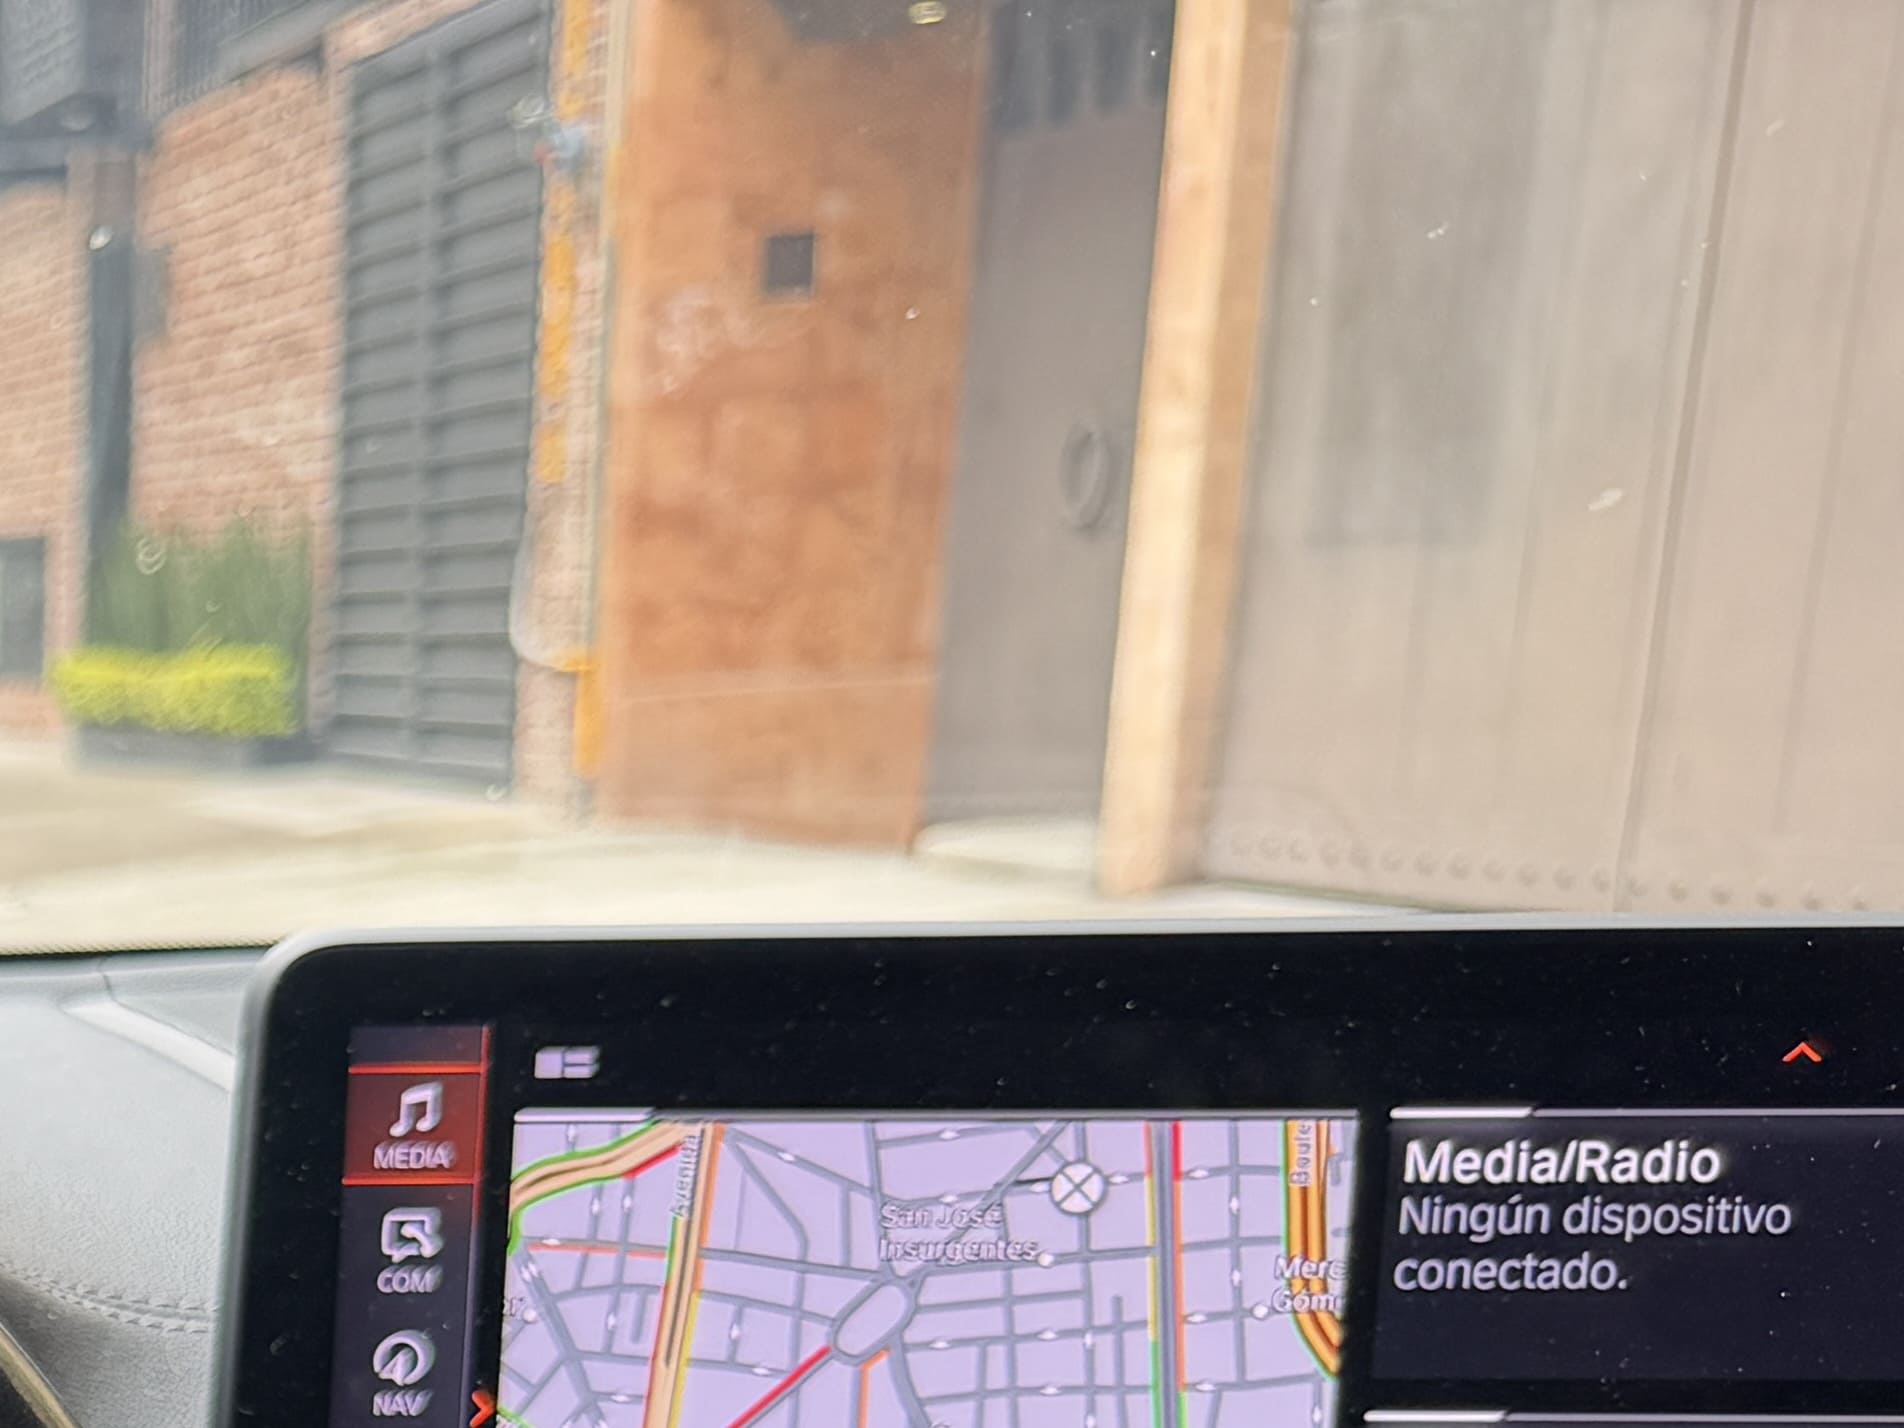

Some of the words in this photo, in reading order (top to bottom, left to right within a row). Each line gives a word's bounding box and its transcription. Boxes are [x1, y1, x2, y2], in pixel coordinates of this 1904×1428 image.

[373, 1141, 456, 1169] MEDIA
[1403, 1140, 1721, 1184] Media/Radio
[881, 1202, 929, 1229] San
[1398, 1195, 1551, 1244] Ningún
[1562, 1195, 1792, 1243] dispositivo
[880, 1238, 1041, 1266] Insurgentes
[376, 1265, 442, 1294] COM
[1392, 1251, 1628, 1291] conectado.
[373, 1388, 433, 1417] NAV
